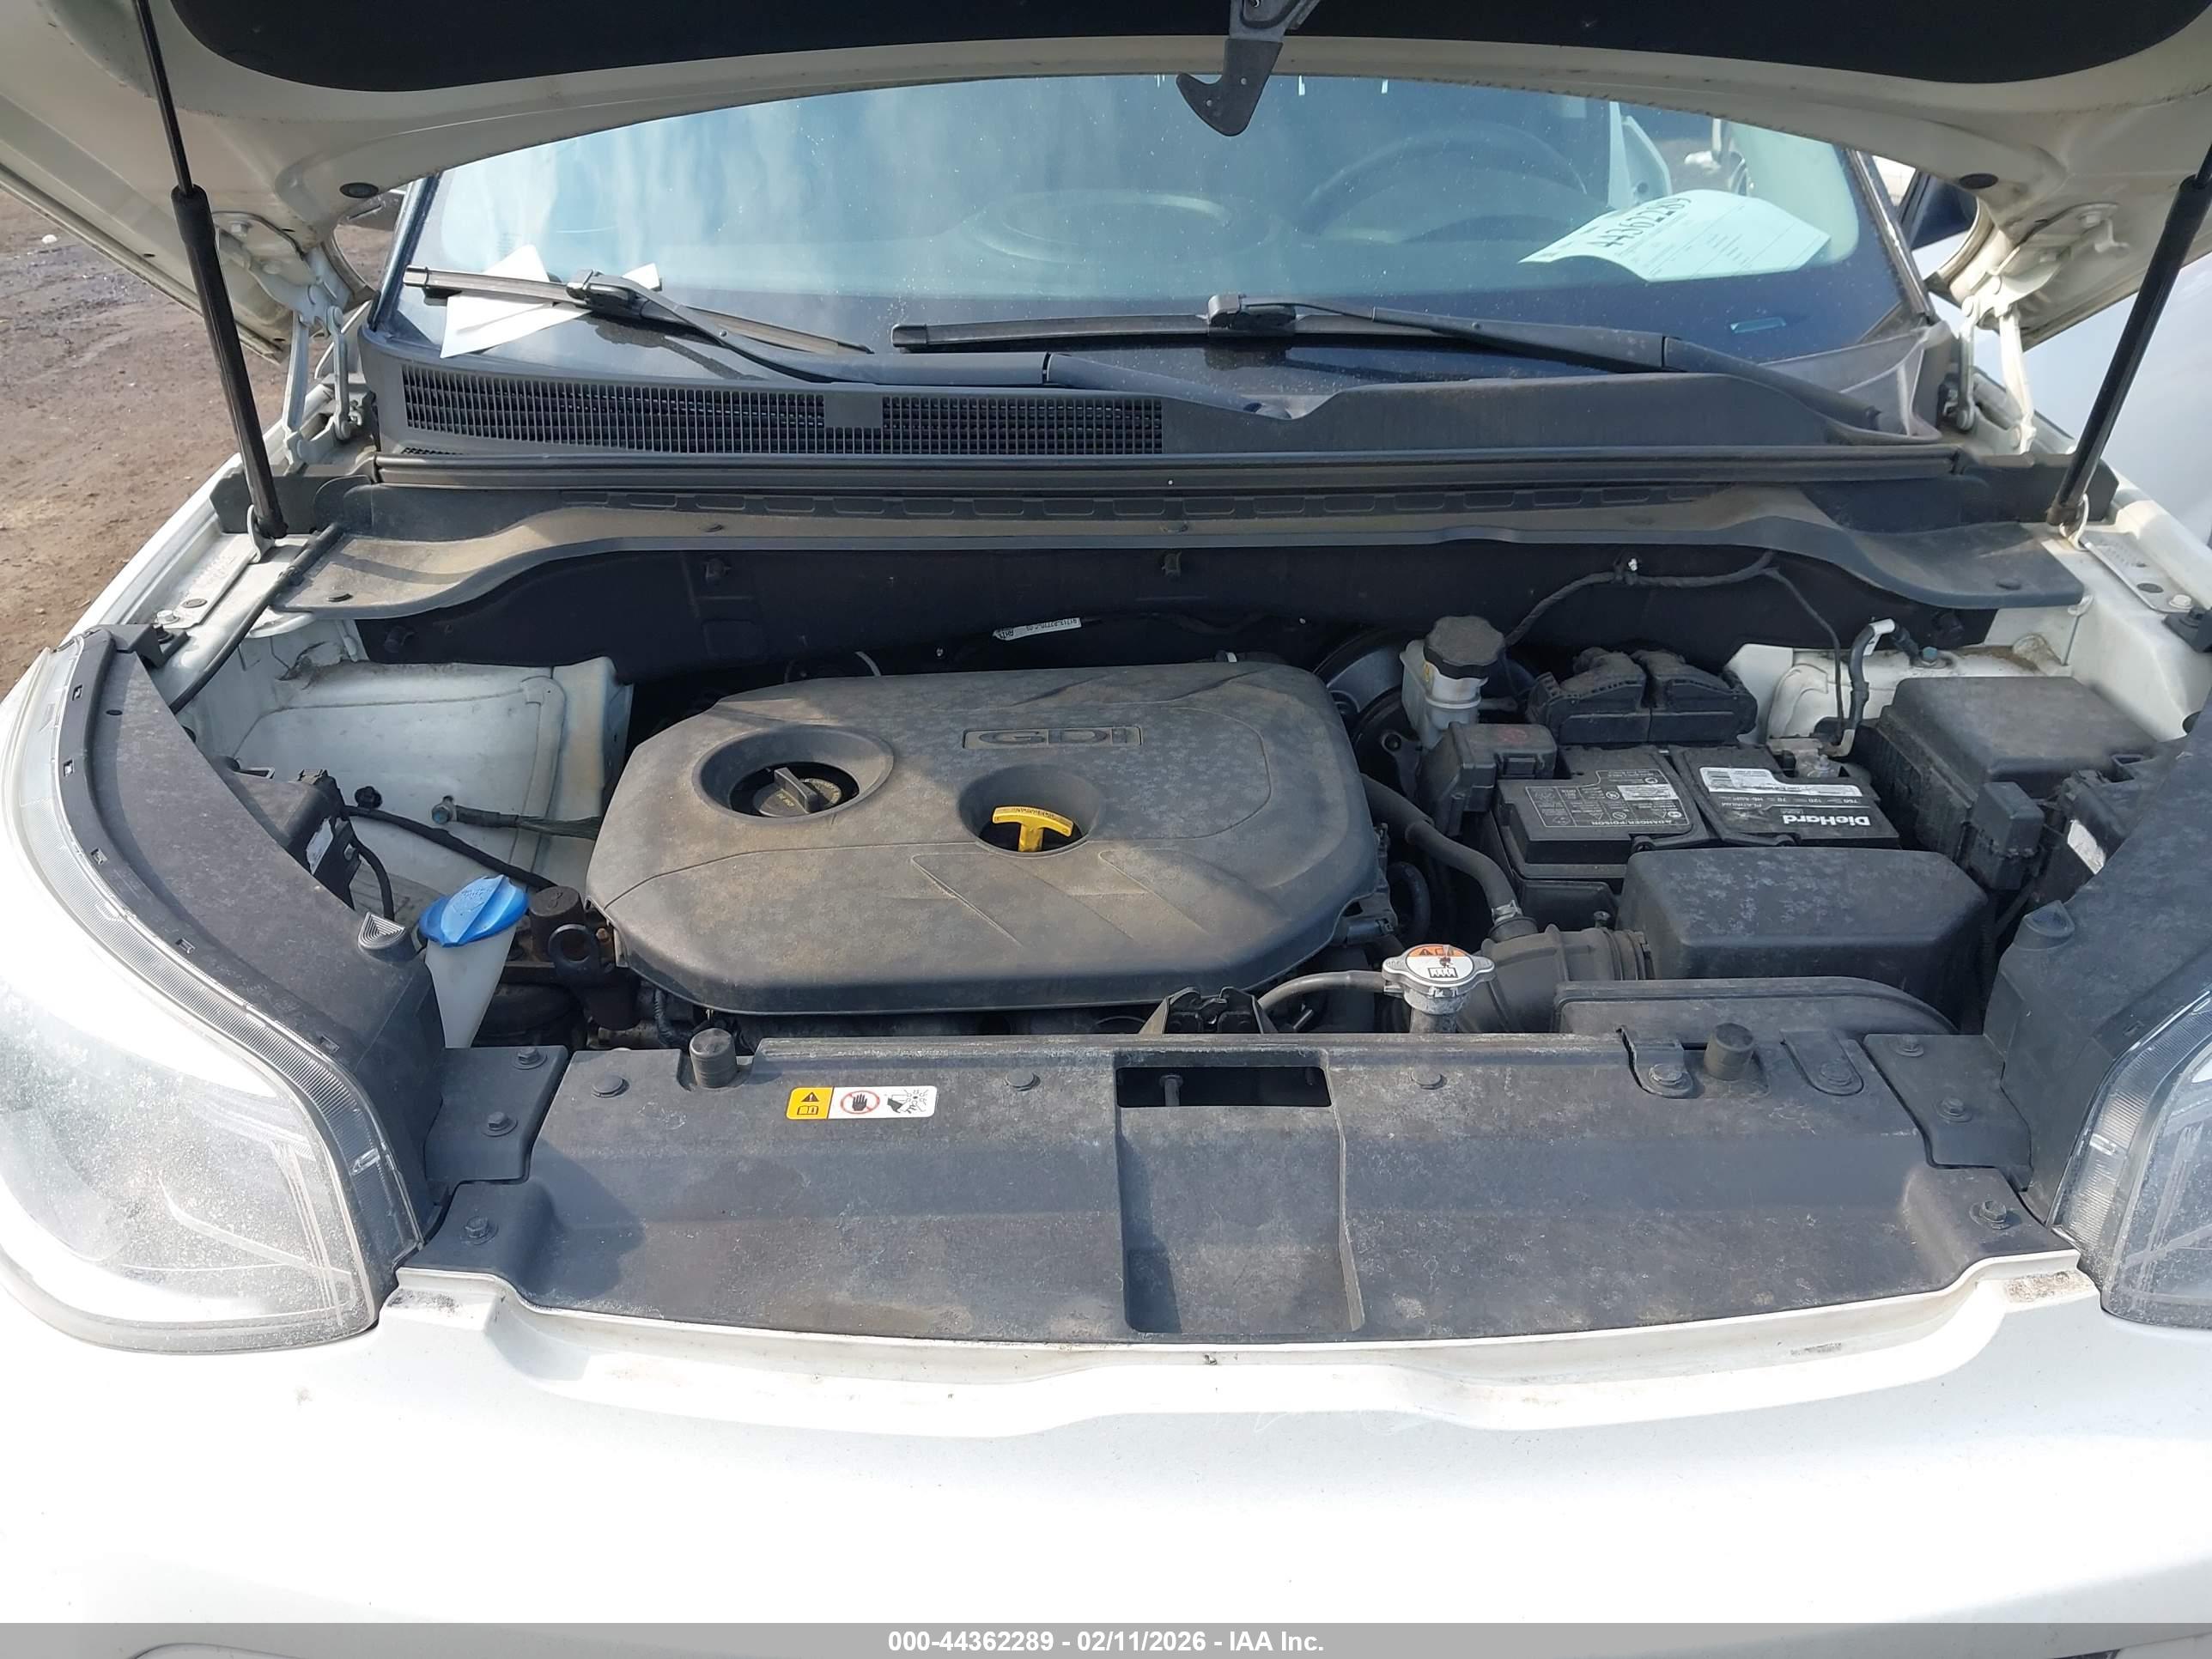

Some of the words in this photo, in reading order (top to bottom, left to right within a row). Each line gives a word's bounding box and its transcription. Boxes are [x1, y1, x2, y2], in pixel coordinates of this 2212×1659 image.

[1588, 198, 1692, 247] 44362289
[978, 727, 1128, 744] GDI
[1783, 815, 1871, 826] DieHard
